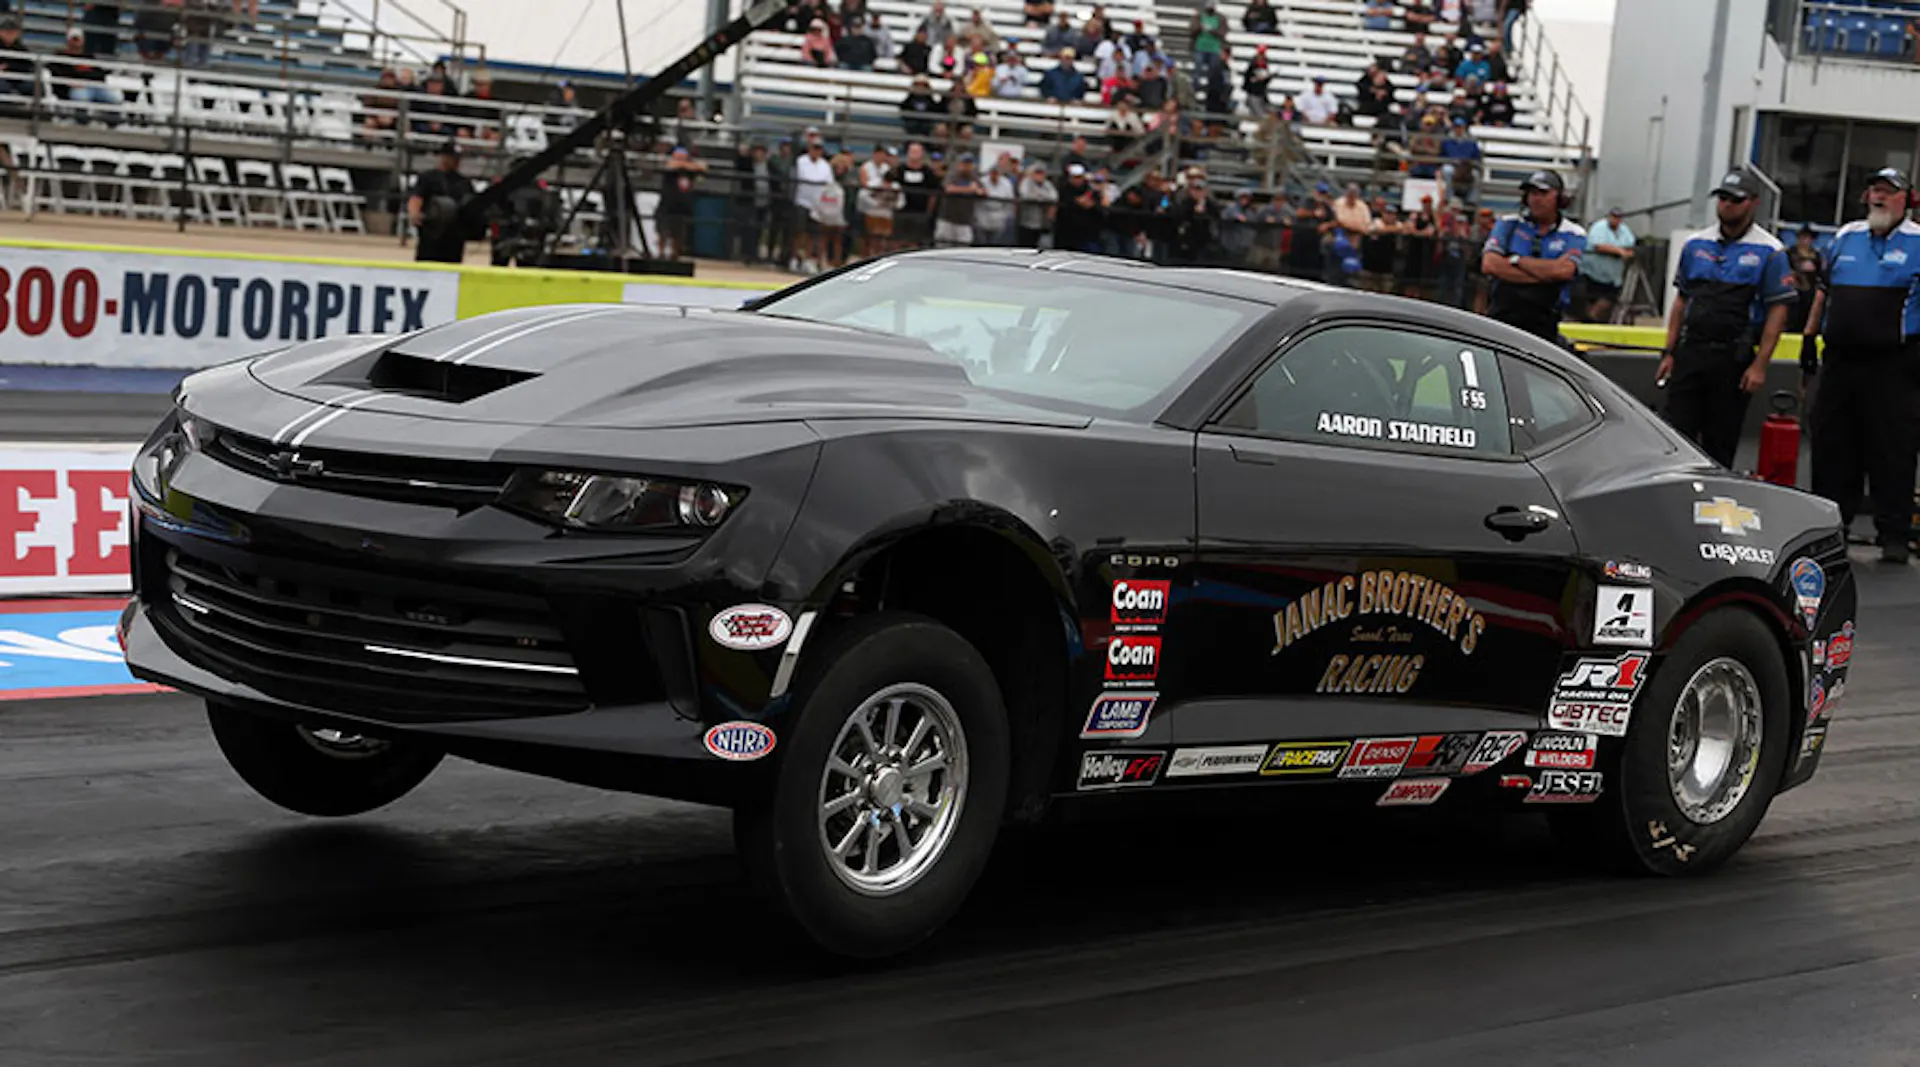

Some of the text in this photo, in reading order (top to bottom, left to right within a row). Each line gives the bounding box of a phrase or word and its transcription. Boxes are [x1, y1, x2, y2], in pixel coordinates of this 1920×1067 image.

[1459, 350, 1479, 388] 1
[1317, 413, 1476, 448] AARON STANFIELD
[1700, 542, 1776, 565] CHEVROLET
[1113, 582, 1163, 610] Coan
[1271, 570, 1486, 656] JANAC BROTHER'S
[1107, 638, 1156, 666] Coan
[1316, 653, 1424, 693] RACING
[1560, 657, 1643, 689] JR1
[1558, 690, 1630, 701] RACING OIL
[1101, 701, 1143, 720] LAMB
[1552, 703, 1628, 725] GIBTEC
[717, 727, 767, 753] NHRA
[1532, 735, 1585, 751] LINCOLN
[1083, 755, 1129, 783] Holley
[1532, 771, 1603, 795] JESEL
